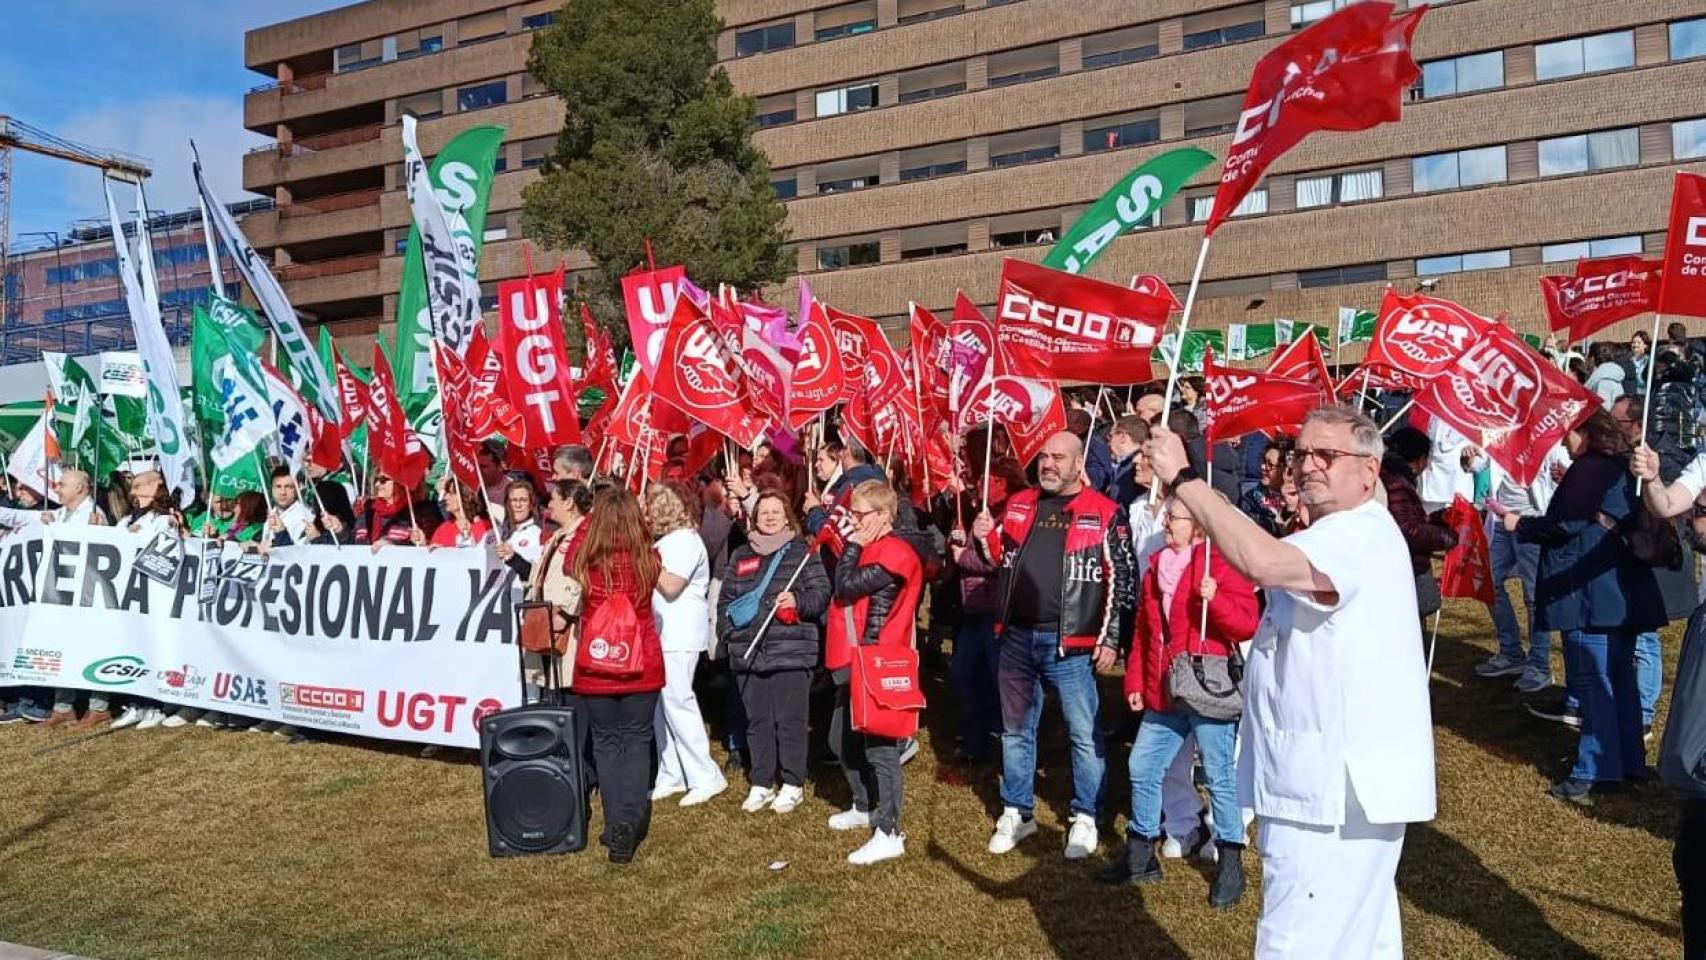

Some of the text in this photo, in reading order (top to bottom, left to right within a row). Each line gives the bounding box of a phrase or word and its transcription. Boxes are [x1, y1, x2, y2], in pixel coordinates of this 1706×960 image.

[1681, 265, 1697, 276] de
[1001, 293, 1110, 341] CCOO
[1396, 312, 1469, 351] UGT
[510, 287, 561, 433] UGT
[1456, 336, 1535, 406] UGT
[983, 390, 1024, 422] UGT
[1069, 556, 1103, 582] life
[455, 568, 513, 644] YA
[100, 663, 150, 678] CSIF
[300, 689, 347, 707] CCOO
[377, 690, 467, 733] UGT
